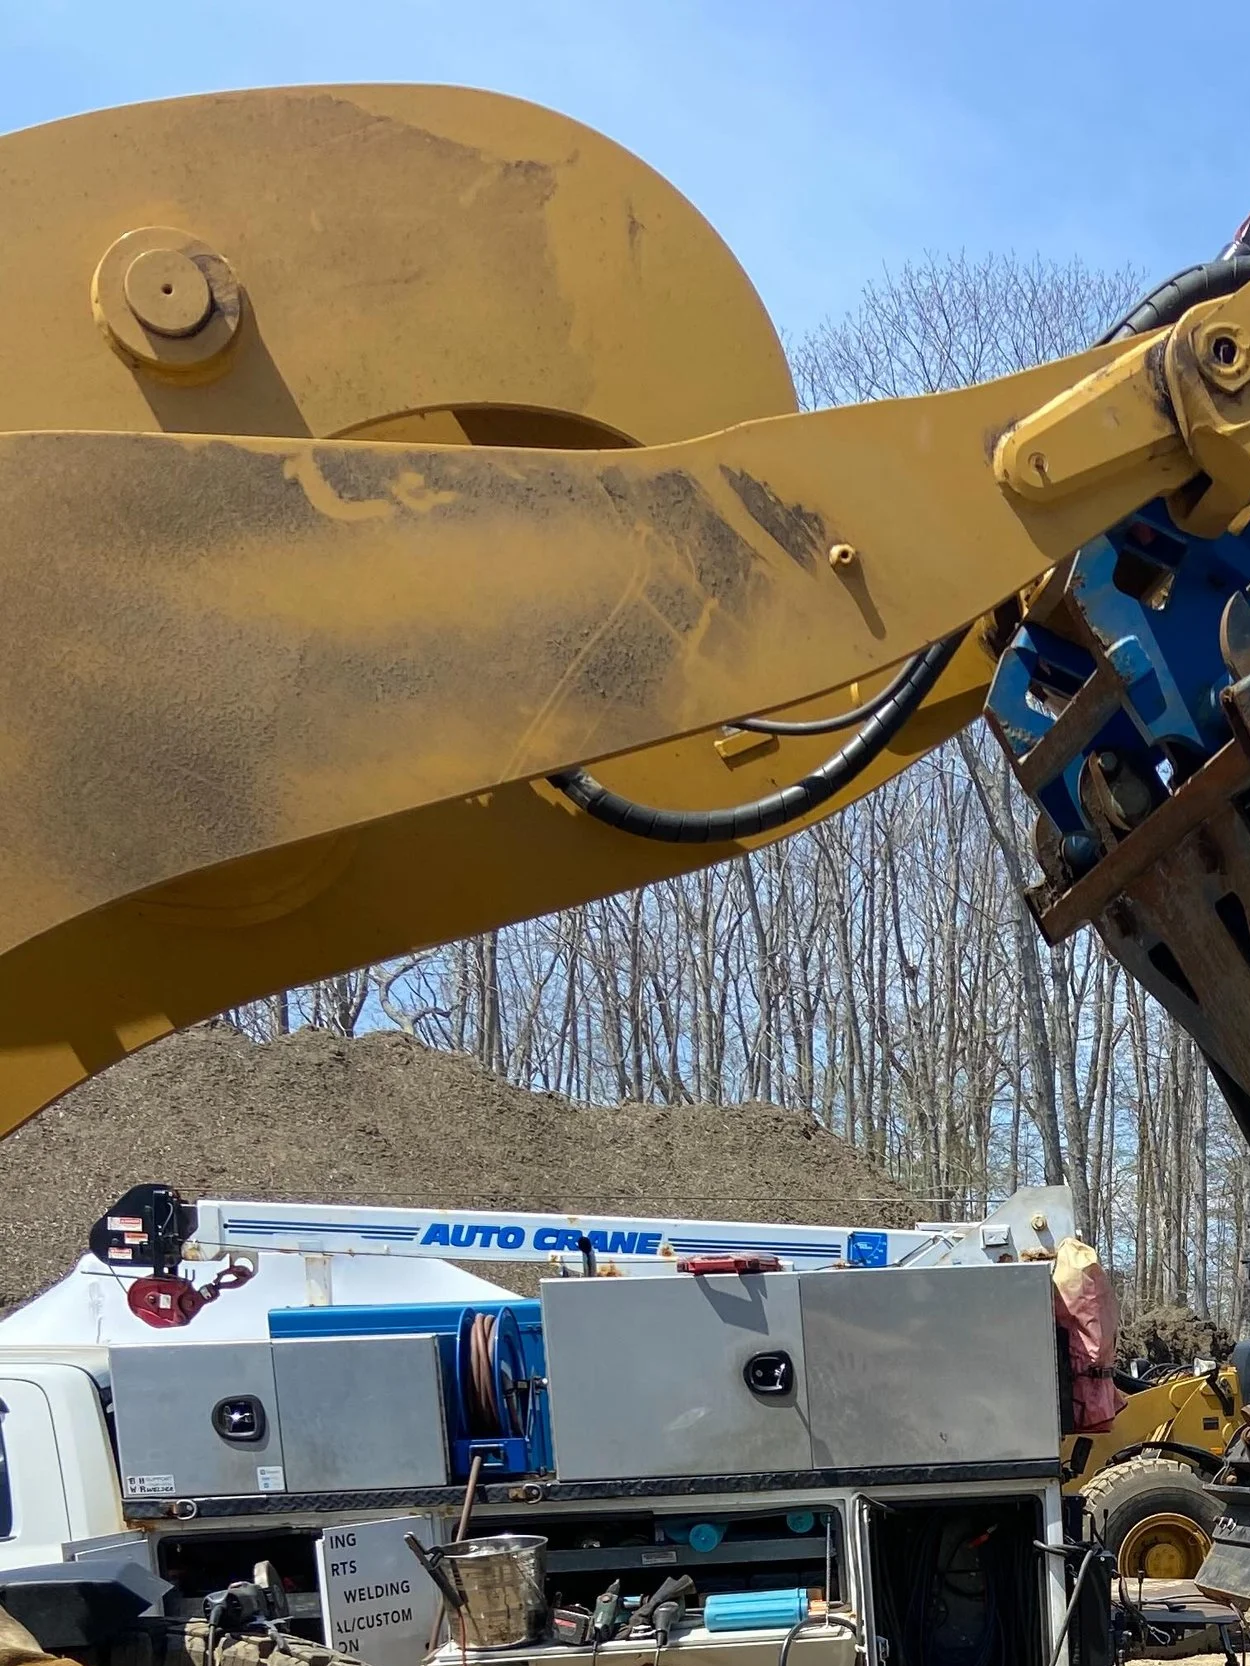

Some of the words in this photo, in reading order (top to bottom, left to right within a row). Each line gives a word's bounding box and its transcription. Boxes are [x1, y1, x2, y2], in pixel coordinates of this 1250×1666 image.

[420, 1223, 525, 1249] AUTO
[533, 1228, 663, 1255] CRANE
[329, 1533, 357, 1549] ING
[331, 1560, 357, 1577] RTS
[344, 1581, 410, 1603] WELDING
